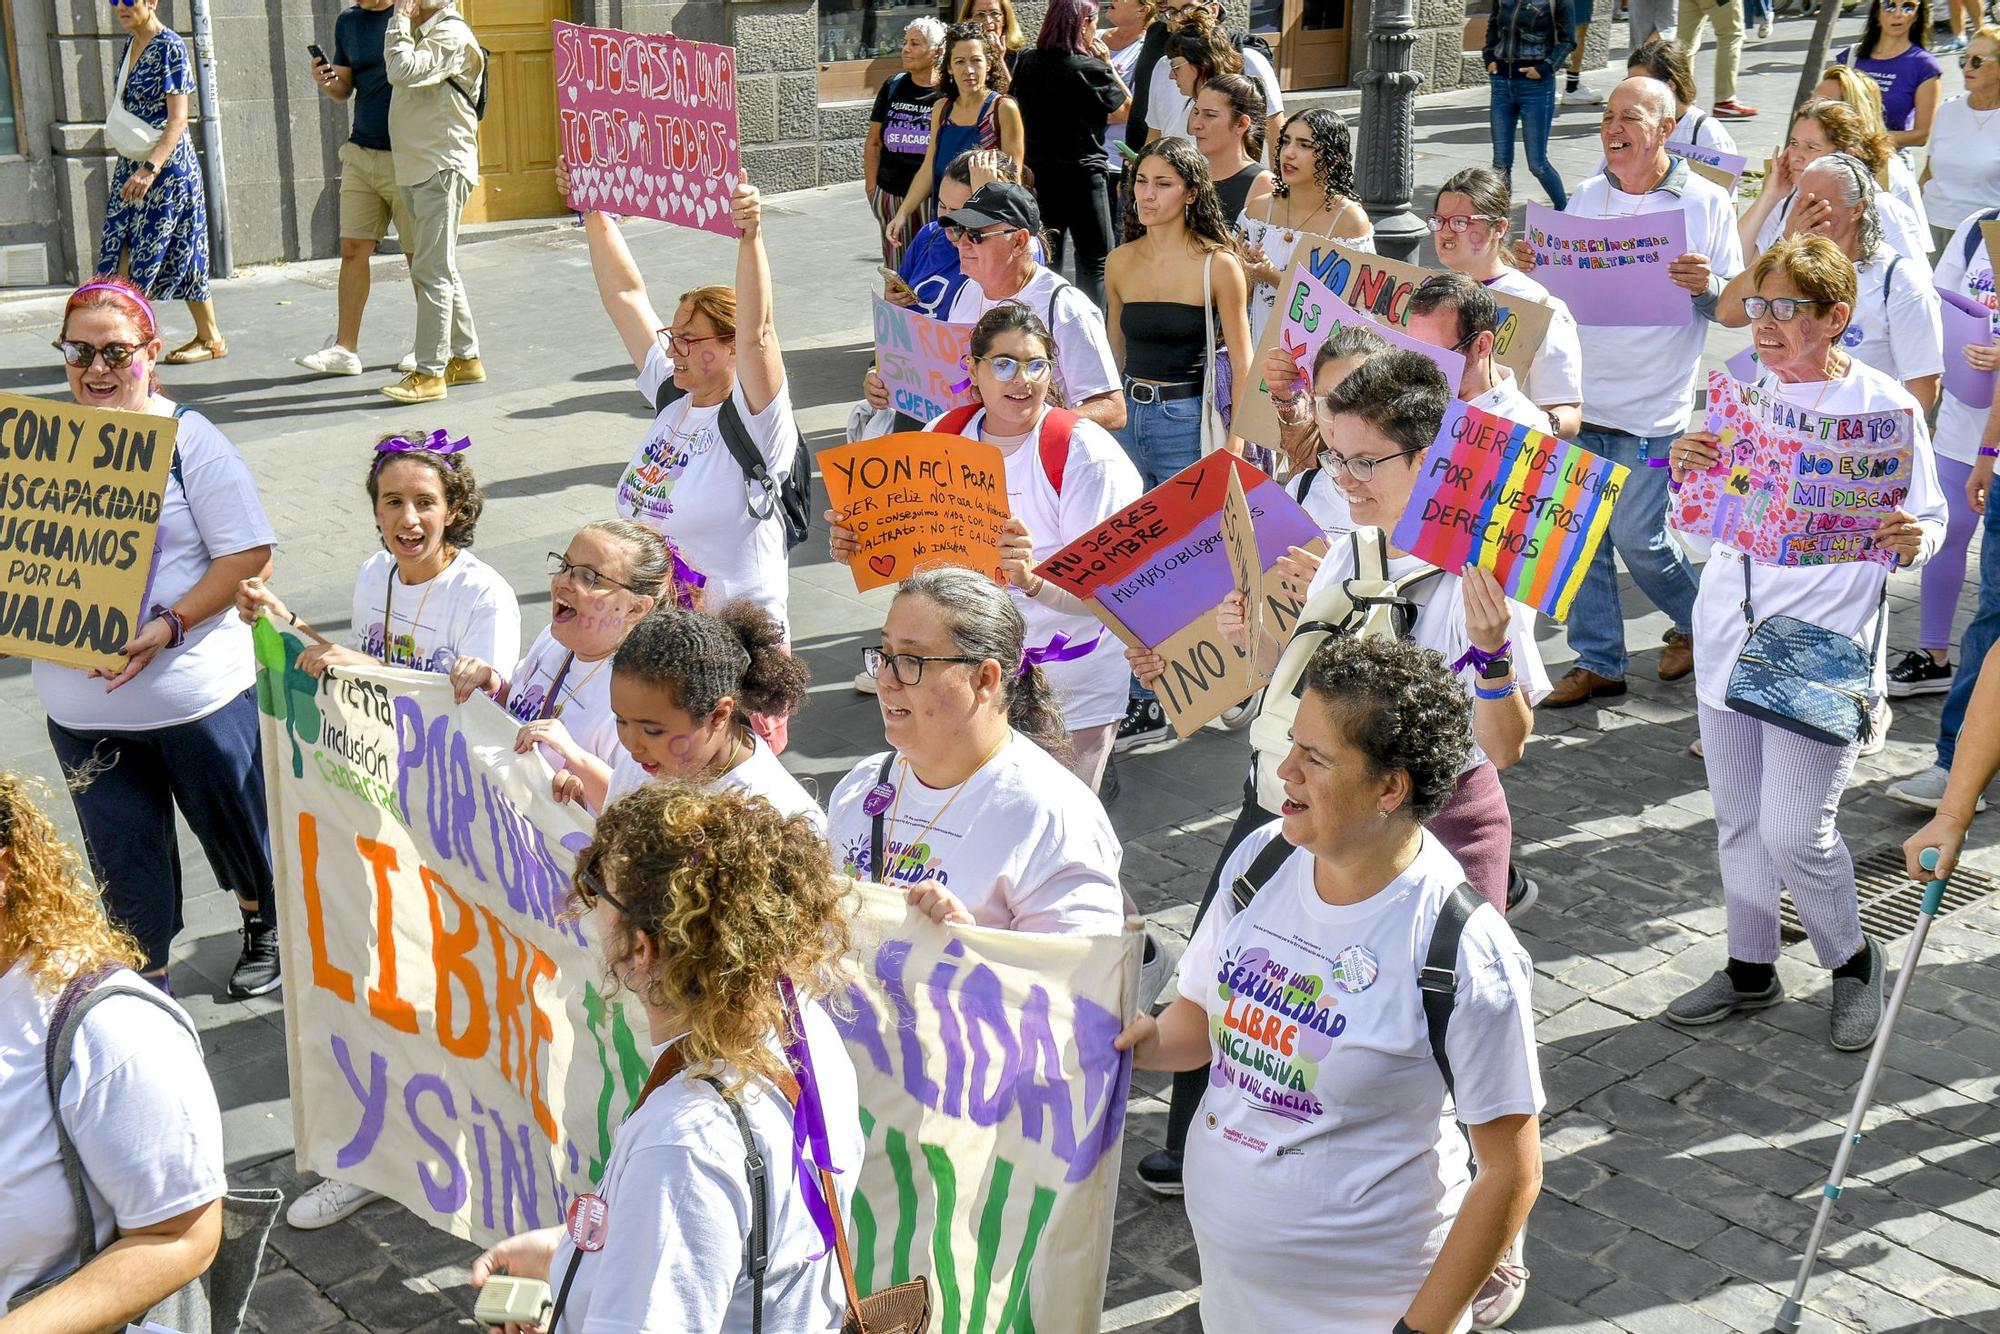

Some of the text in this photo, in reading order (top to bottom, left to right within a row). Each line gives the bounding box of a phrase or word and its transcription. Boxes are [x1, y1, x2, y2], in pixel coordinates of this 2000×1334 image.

[589, 34, 672, 100] TOCAS
[673, 47, 689, 108] A
[695, 51, 732, 110] UNA
[561, 108, 730, 181] TOCAS A TODAS
[1529, 225, 1545, 248] NO
[1536, 252, 1550, 267] ON
[1579, 251, 1660, 270] MALTRATOS
[911, 313, 971, 365] ROP
[0, 407, 157, 473] CON Y SIN
[1773, 402, 1896, 442] MALTRATO
[1176, 468, 1205, 500] Y
[1450, 415, 1620, 506] QUEREMOS LUCHAR
[1799, 451, 1833, 475] NO
[0, 471, 162, 523] ISCAPACIDAD
[842, 497, 879, 522] SER
[930, 487, 946, 504] NO
[1430, 456, 1584, 534] POR NUESTROS
[1793, 480, 1826, 507] MI
[0, 516, 140, 570] UCHAMOS
[931, 522, 946, 536] NO
[950, 525, 965, 538] TE
[1421, 498, 1539, 560] DERECHOS
[1817, 512, 1856, 530] NO
[8, 559, 81, 591] POR LA
[0, 591, 129, 654] UALDAD
[320, 709, 390, 785] inclusión
[392, 695, 488, 883] POR
[298, 811, 559, 1145] LIBRE
[1262, 959, 1317, 996] POR UNA
[1223, 995, 1298, 1057] LIBRE
[330, 1033, 388, 1170] Y
[1238, 1070, 1324, 1116] VIOLENCIAS
[573, 1196, 588, 1243] FEMINISTAS
[585, 1200, 606, 1251] PUTS
